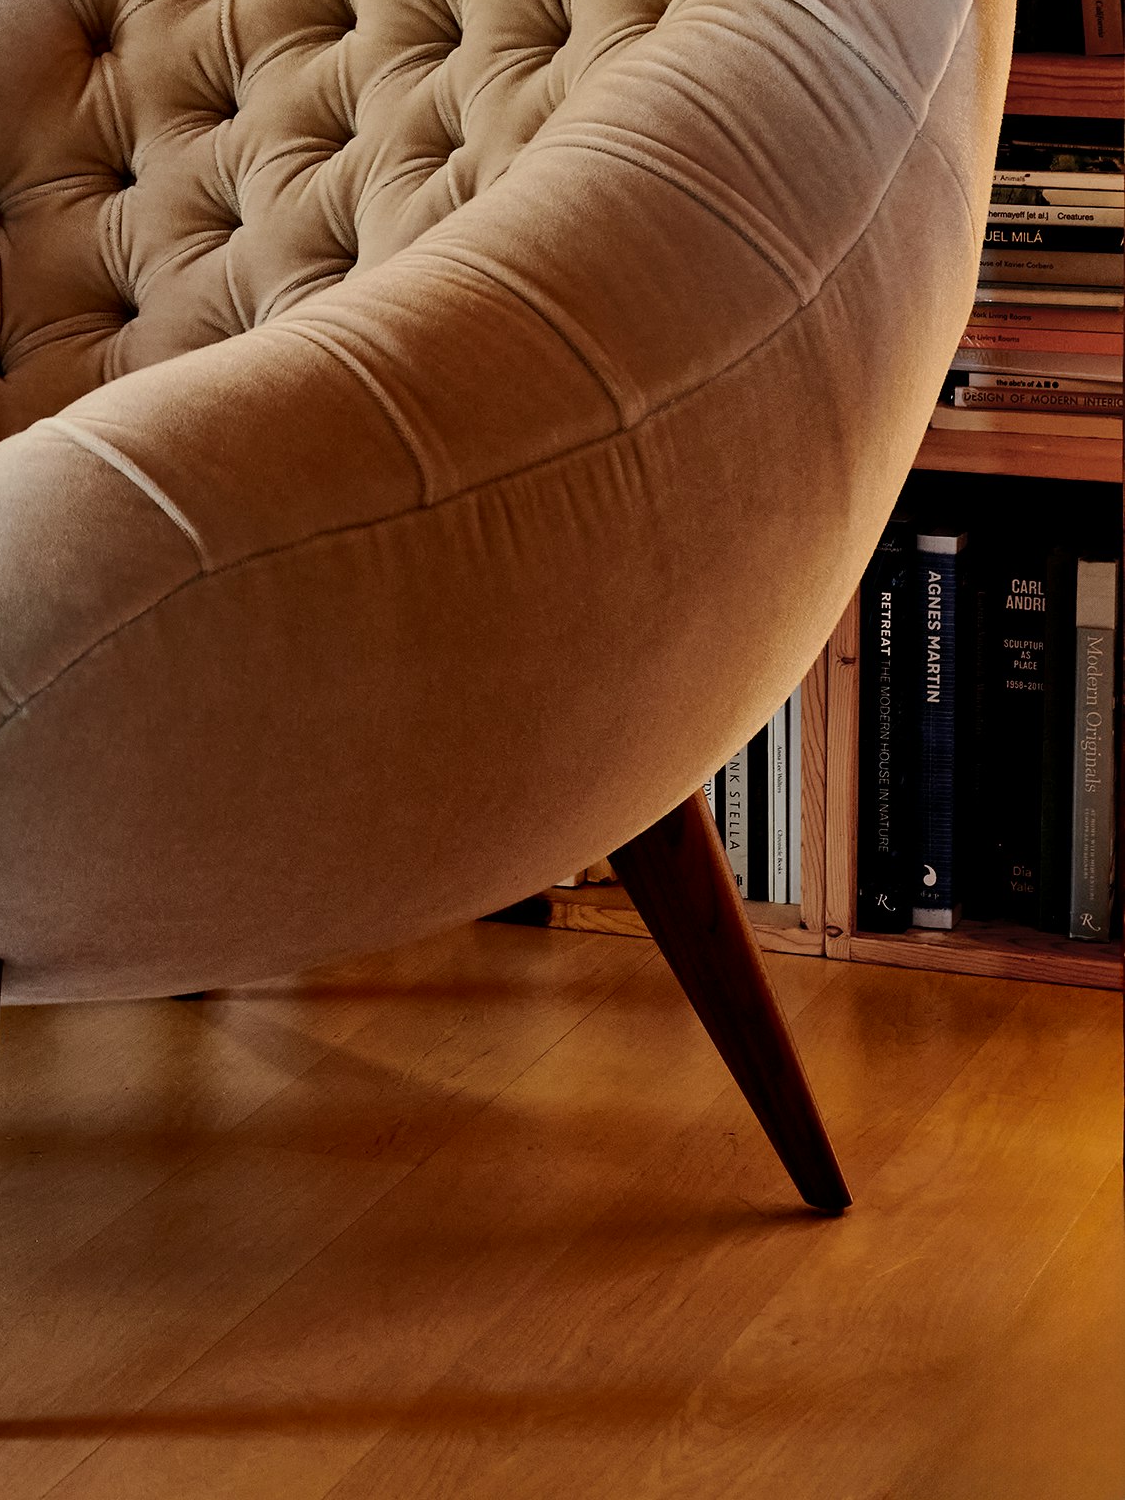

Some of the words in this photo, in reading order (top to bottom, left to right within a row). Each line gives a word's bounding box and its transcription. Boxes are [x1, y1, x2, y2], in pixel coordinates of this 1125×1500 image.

[1000, 174, 1026, 183] Animals
[1011, 229, 1043, 244] MILÁ
[1004, 260, 1025, 269] Xavier
[1027, 261, 1054, 271] Corberó
[963, 391, 1004, 404] DESIGN
[1010, 391, 1026, 404] OF
[1031, 395, 1078, 406] MODERN
[1011, 578, 1045, 595] CARL
[928, 570, 942, 631] AGNES
[881, 591, 892, 656] RETREAT
[927, 635, 941, 704] MARTIN
[1013, 661, 1038, 671] PLACE
[1087, 634, 1104, 706] Modern
[1079, 711, 1102, 794] Originals
[729, 793, 740, 850] STELLA
[1012, 866, 1032, 878] Dia
[1010, 881, 1034, 893] Yale
